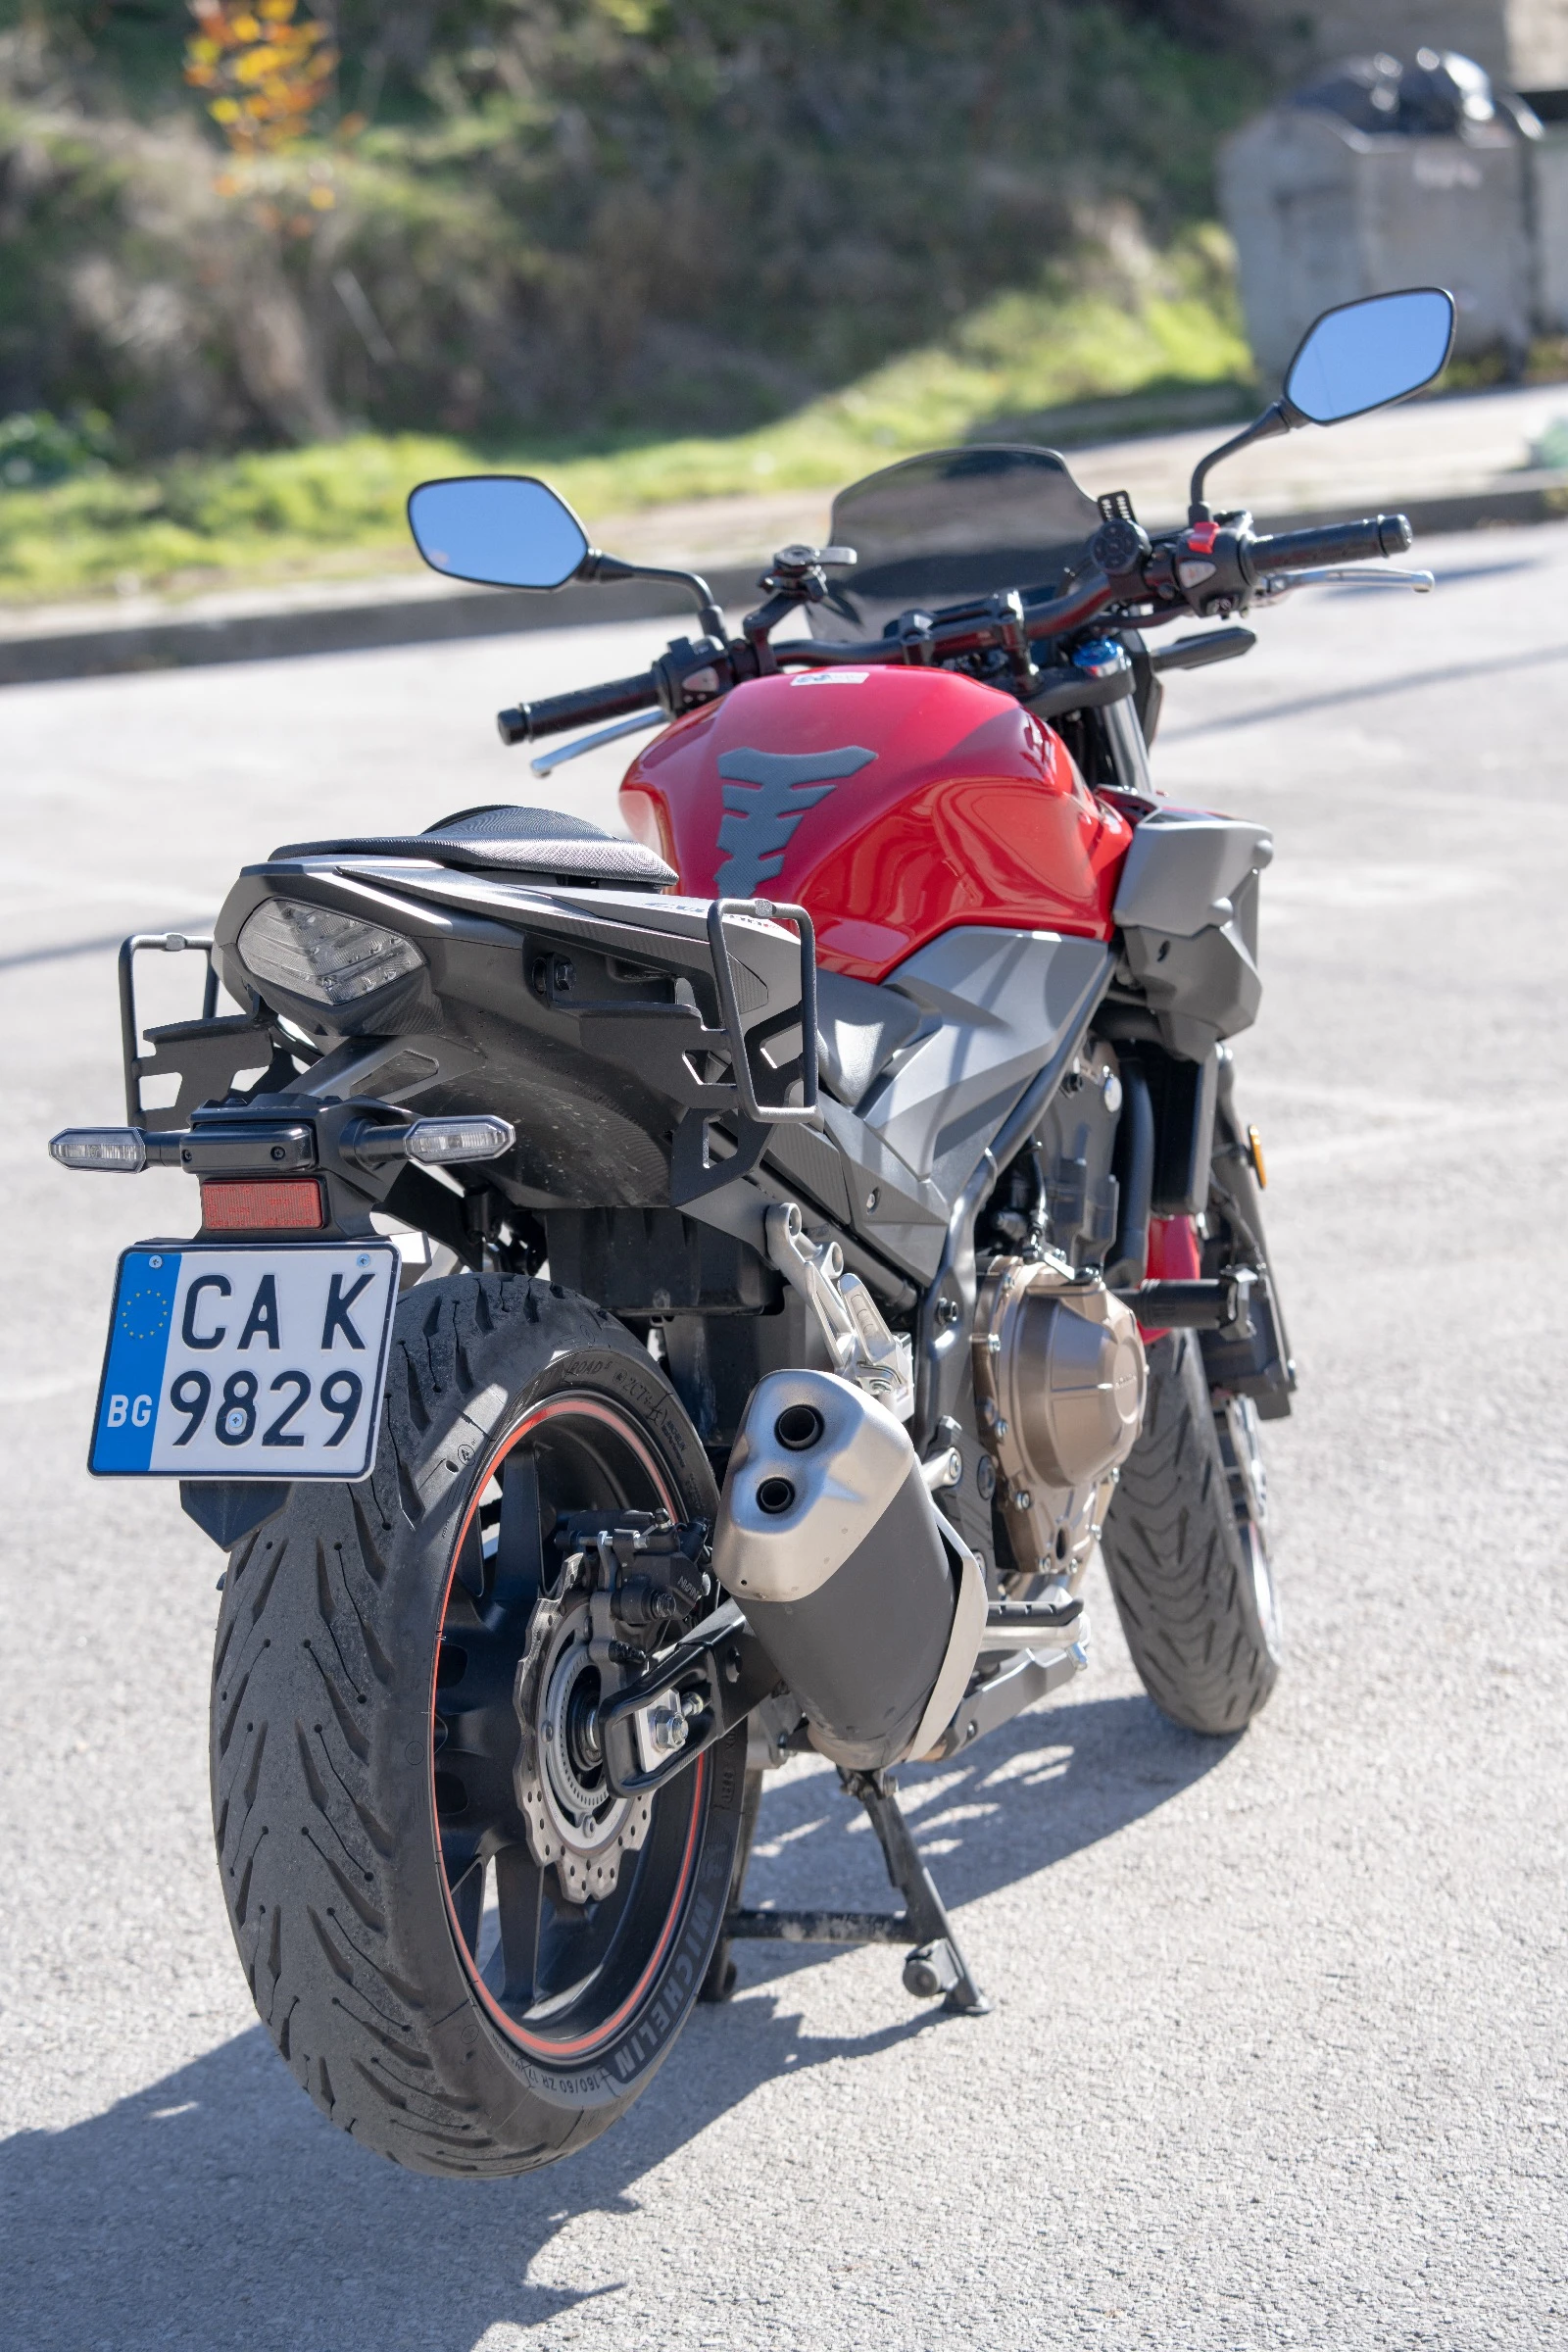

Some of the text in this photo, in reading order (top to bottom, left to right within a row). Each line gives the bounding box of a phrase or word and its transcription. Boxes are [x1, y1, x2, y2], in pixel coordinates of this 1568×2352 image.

[181, 1274, 376, 1349] CA K
[107, 1395, 152, 1427] BG
[170, 1370, 363, 1446] 9829
[614, 1891, 714, 2078] MICHELIN
[560, 2074, 600, 2093] 160/60
